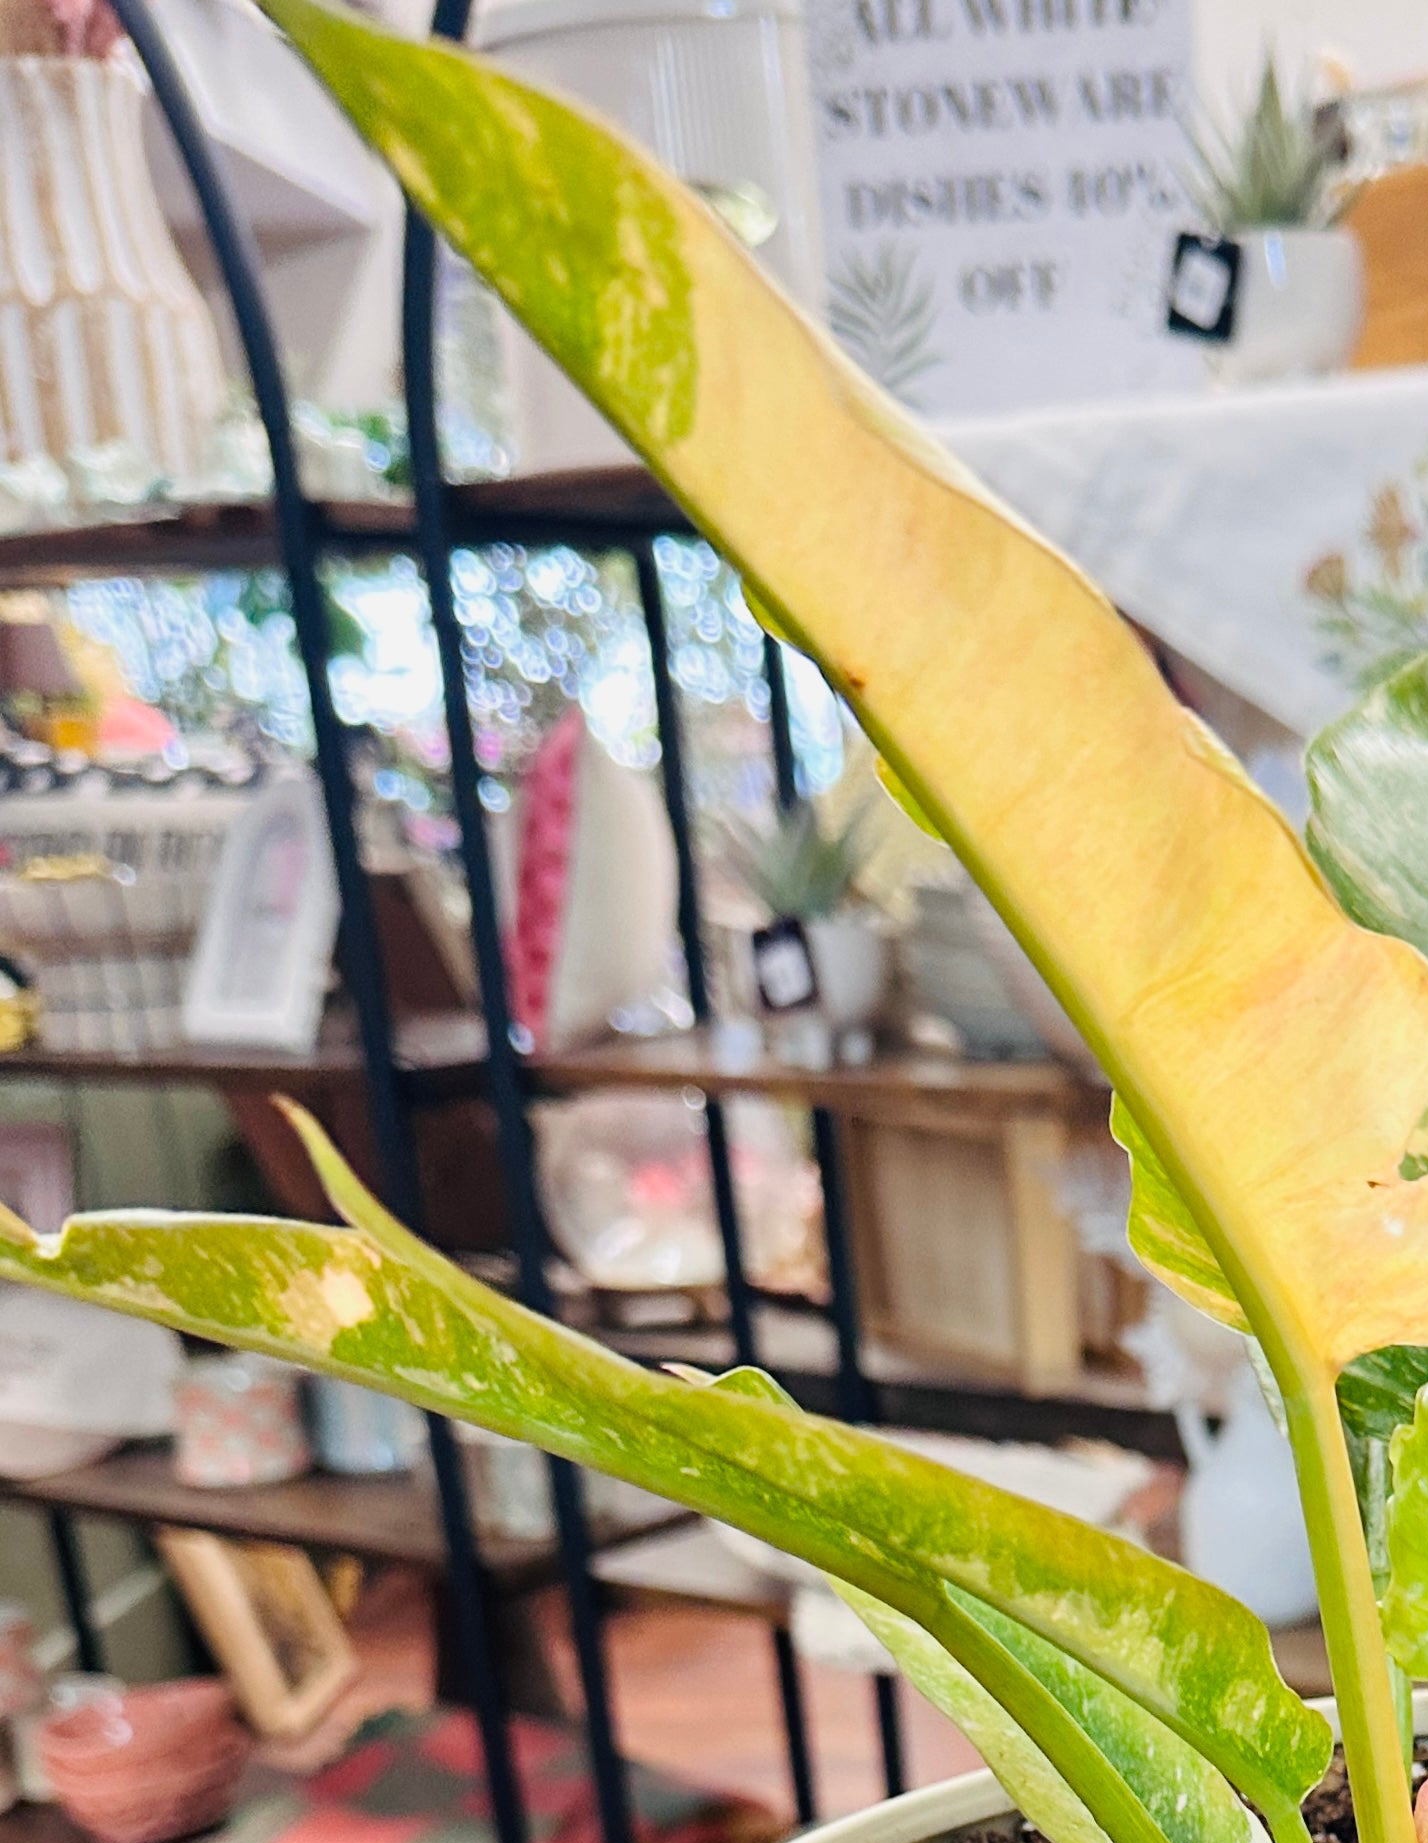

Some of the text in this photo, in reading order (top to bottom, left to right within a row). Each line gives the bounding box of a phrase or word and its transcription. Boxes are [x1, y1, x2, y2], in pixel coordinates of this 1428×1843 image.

[846, 0, 1162, 43] ALL WHITE
[824, 67, 1176, 140] STONEWARE
[844, 171, 1050, 231] DISHES
[956, 259, 1058, 314] OFF
